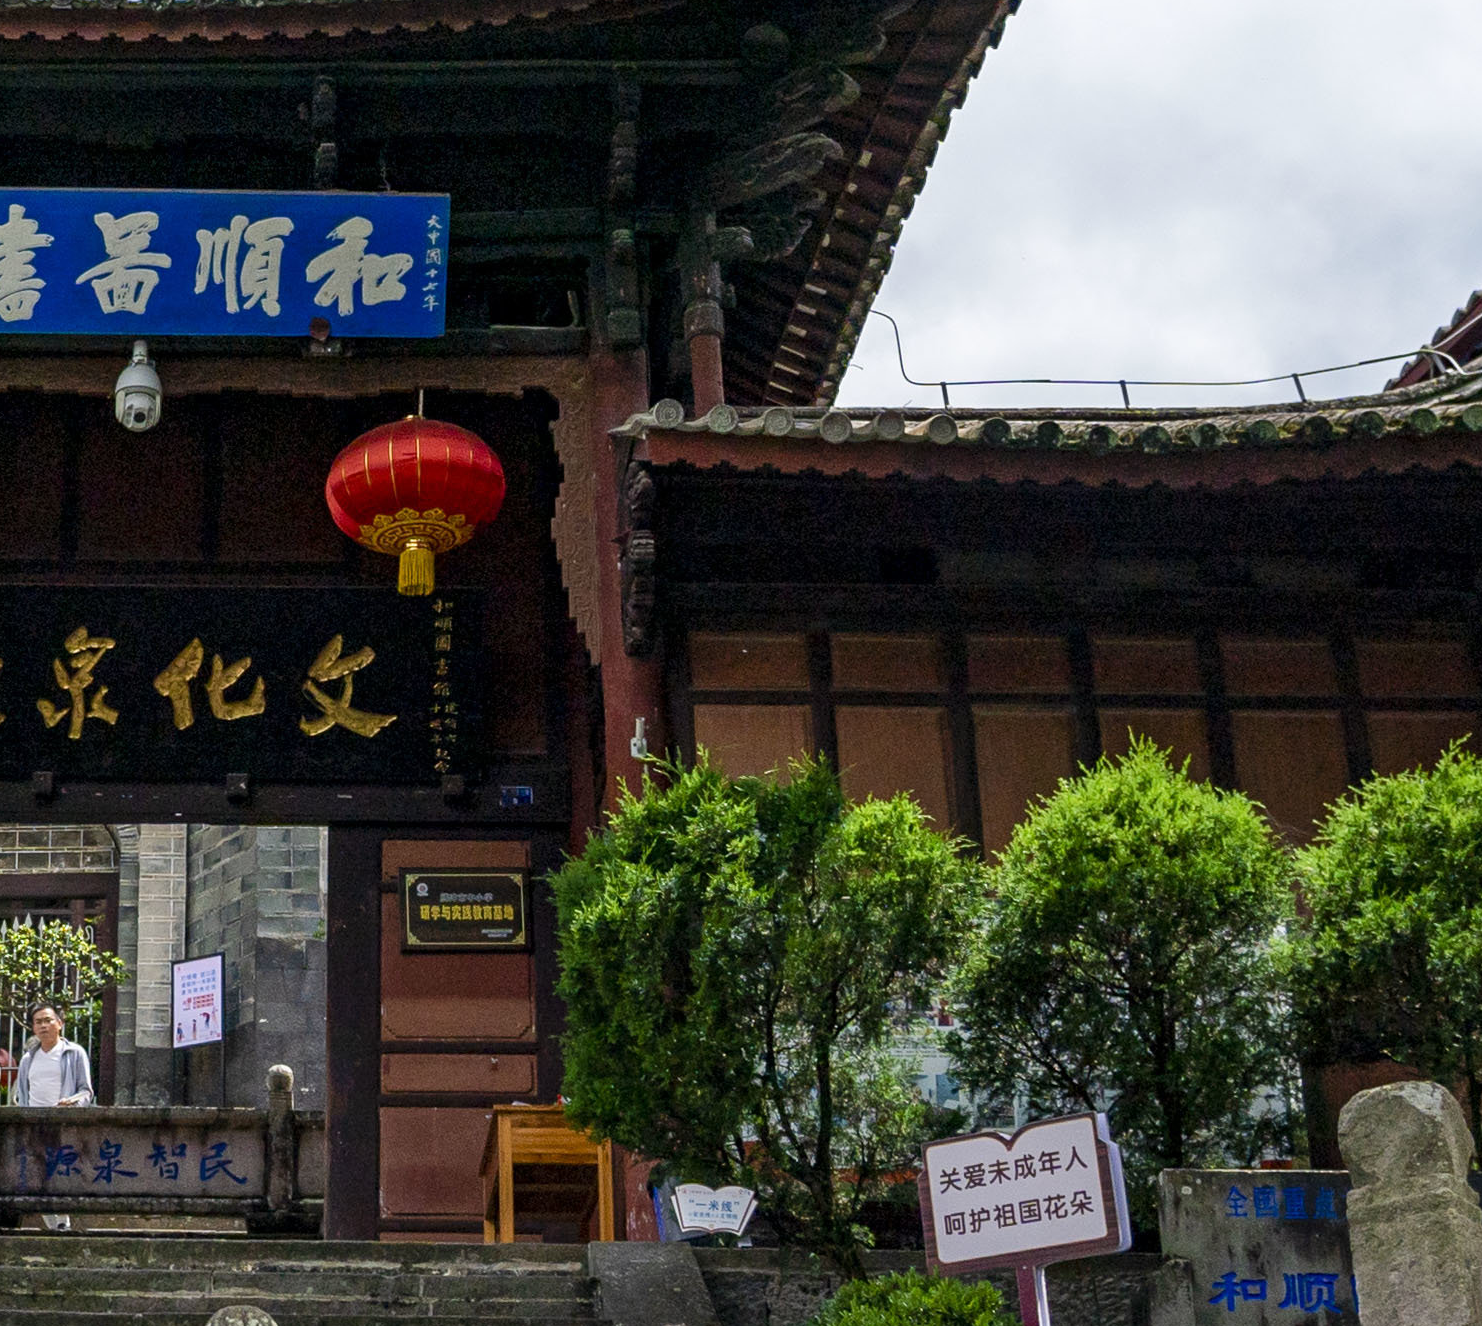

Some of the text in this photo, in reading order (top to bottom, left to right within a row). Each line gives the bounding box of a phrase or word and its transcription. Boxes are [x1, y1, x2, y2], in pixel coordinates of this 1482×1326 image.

[940, 1146, 1088, 1194] 关爱未成年人
[944, 1190, 1094, 1236] 呵护祖国花朵
